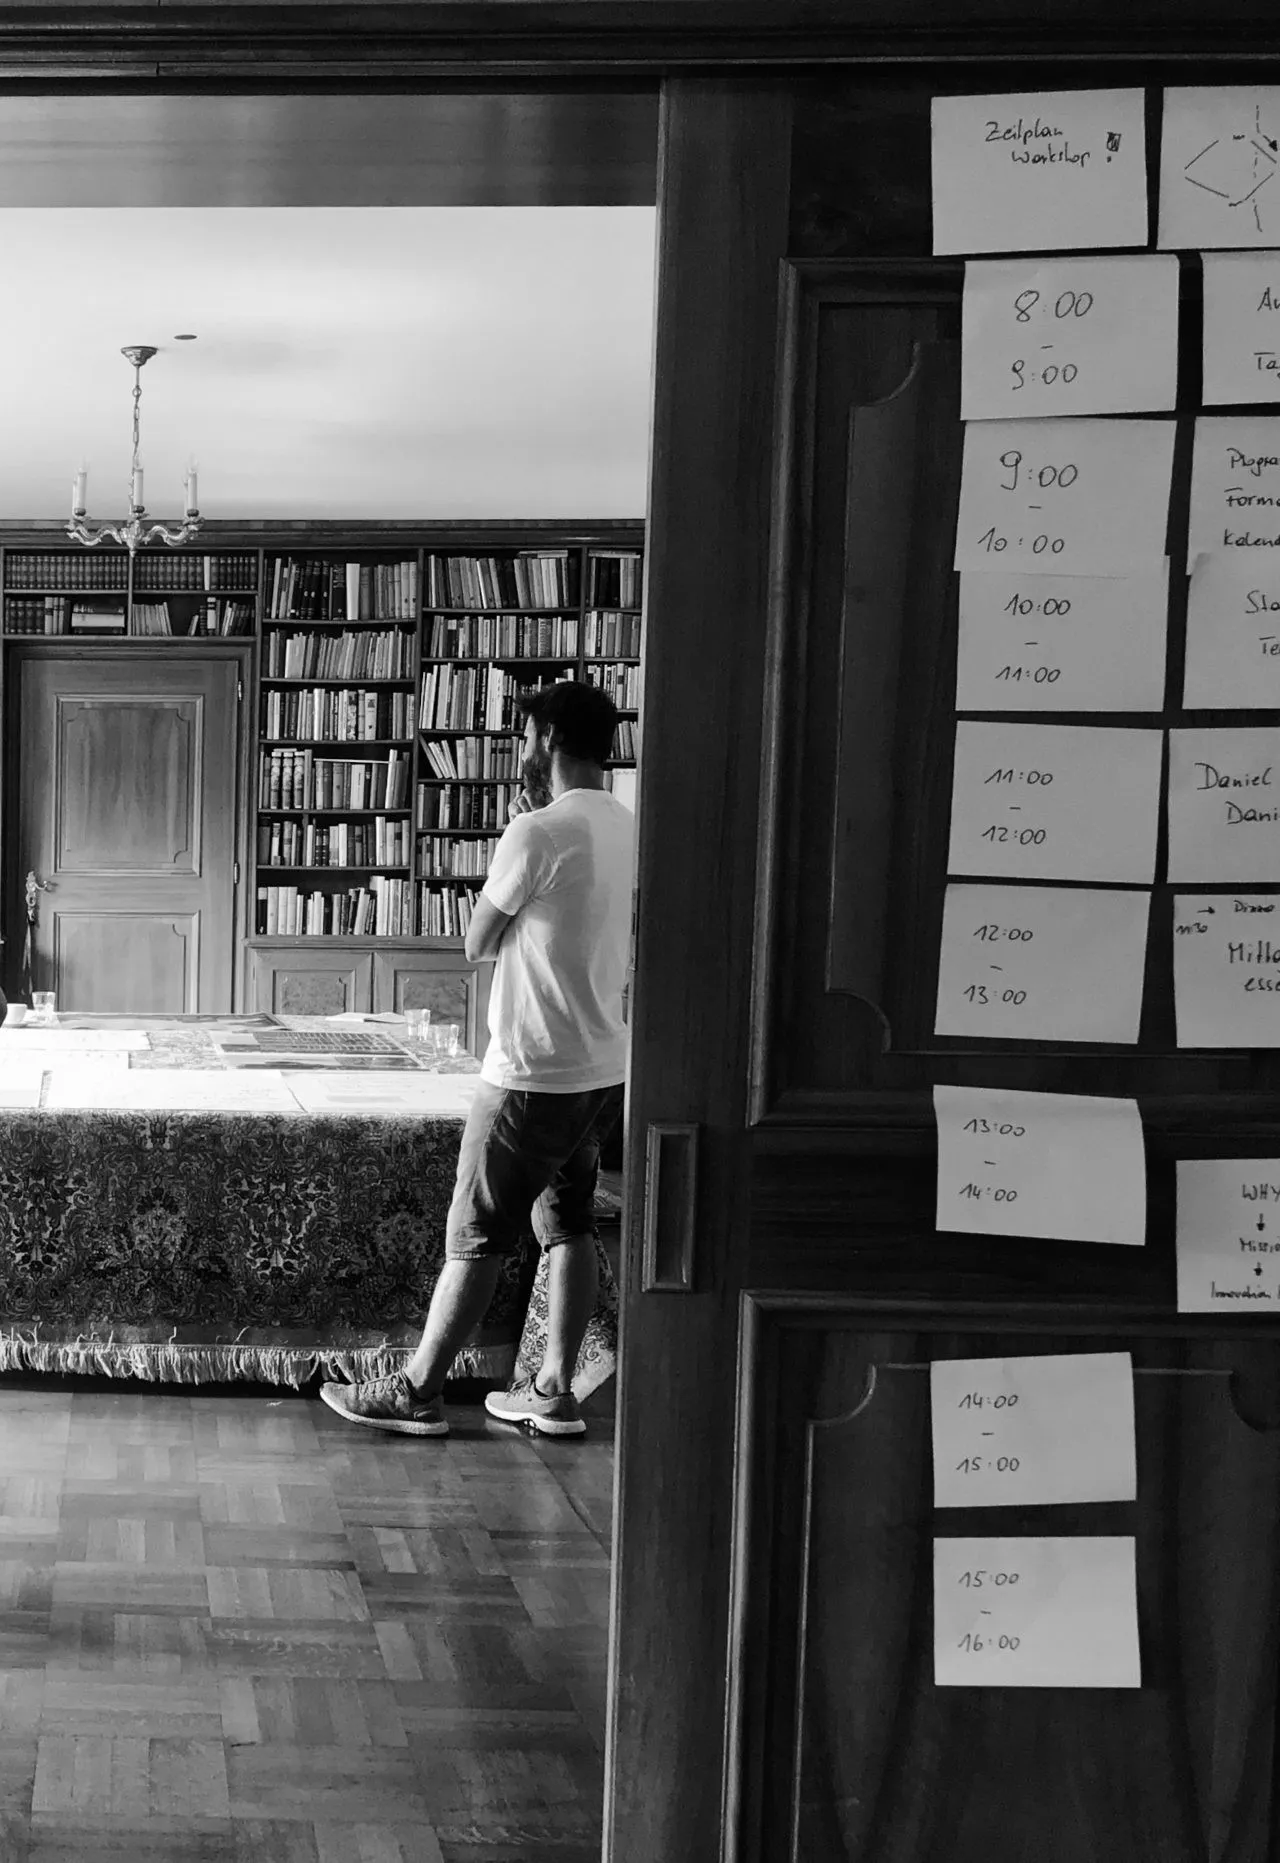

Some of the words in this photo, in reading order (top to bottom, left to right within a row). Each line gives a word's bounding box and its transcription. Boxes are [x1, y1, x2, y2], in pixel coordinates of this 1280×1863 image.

[985, 118, 1063, 145] Zeitplan
[1014, 289, 1094, 322] 8:00
[1008, 360, 1078, 390] 9:00
[999, 450, 1078, 490] 9:00
[977, 527, 1065, 554] 10:00
[1004, 593, 1071, 616] 10:00
[995, 666, 1061, 684] 11:00
[984, 769, 1053, 786] 11:00
[1194, 763, 1272, 790] Daniel
[981, 825, 1046, 845] 12:00
[973, 925, 1033, 942] 12:00
[963, 985, 1027, 1005] 13:00
[963, 1119, 1025, 1137] 13:00
[959, 1183, 1018, 1202] 14:00
[958, 1392, 1019, 1409] 14:00
[956, 1456, 1020, 1474] 15:00
[958, 1571, 1019, 1588] 15:00
[958, 1633, 1020, 1653] 16:00
